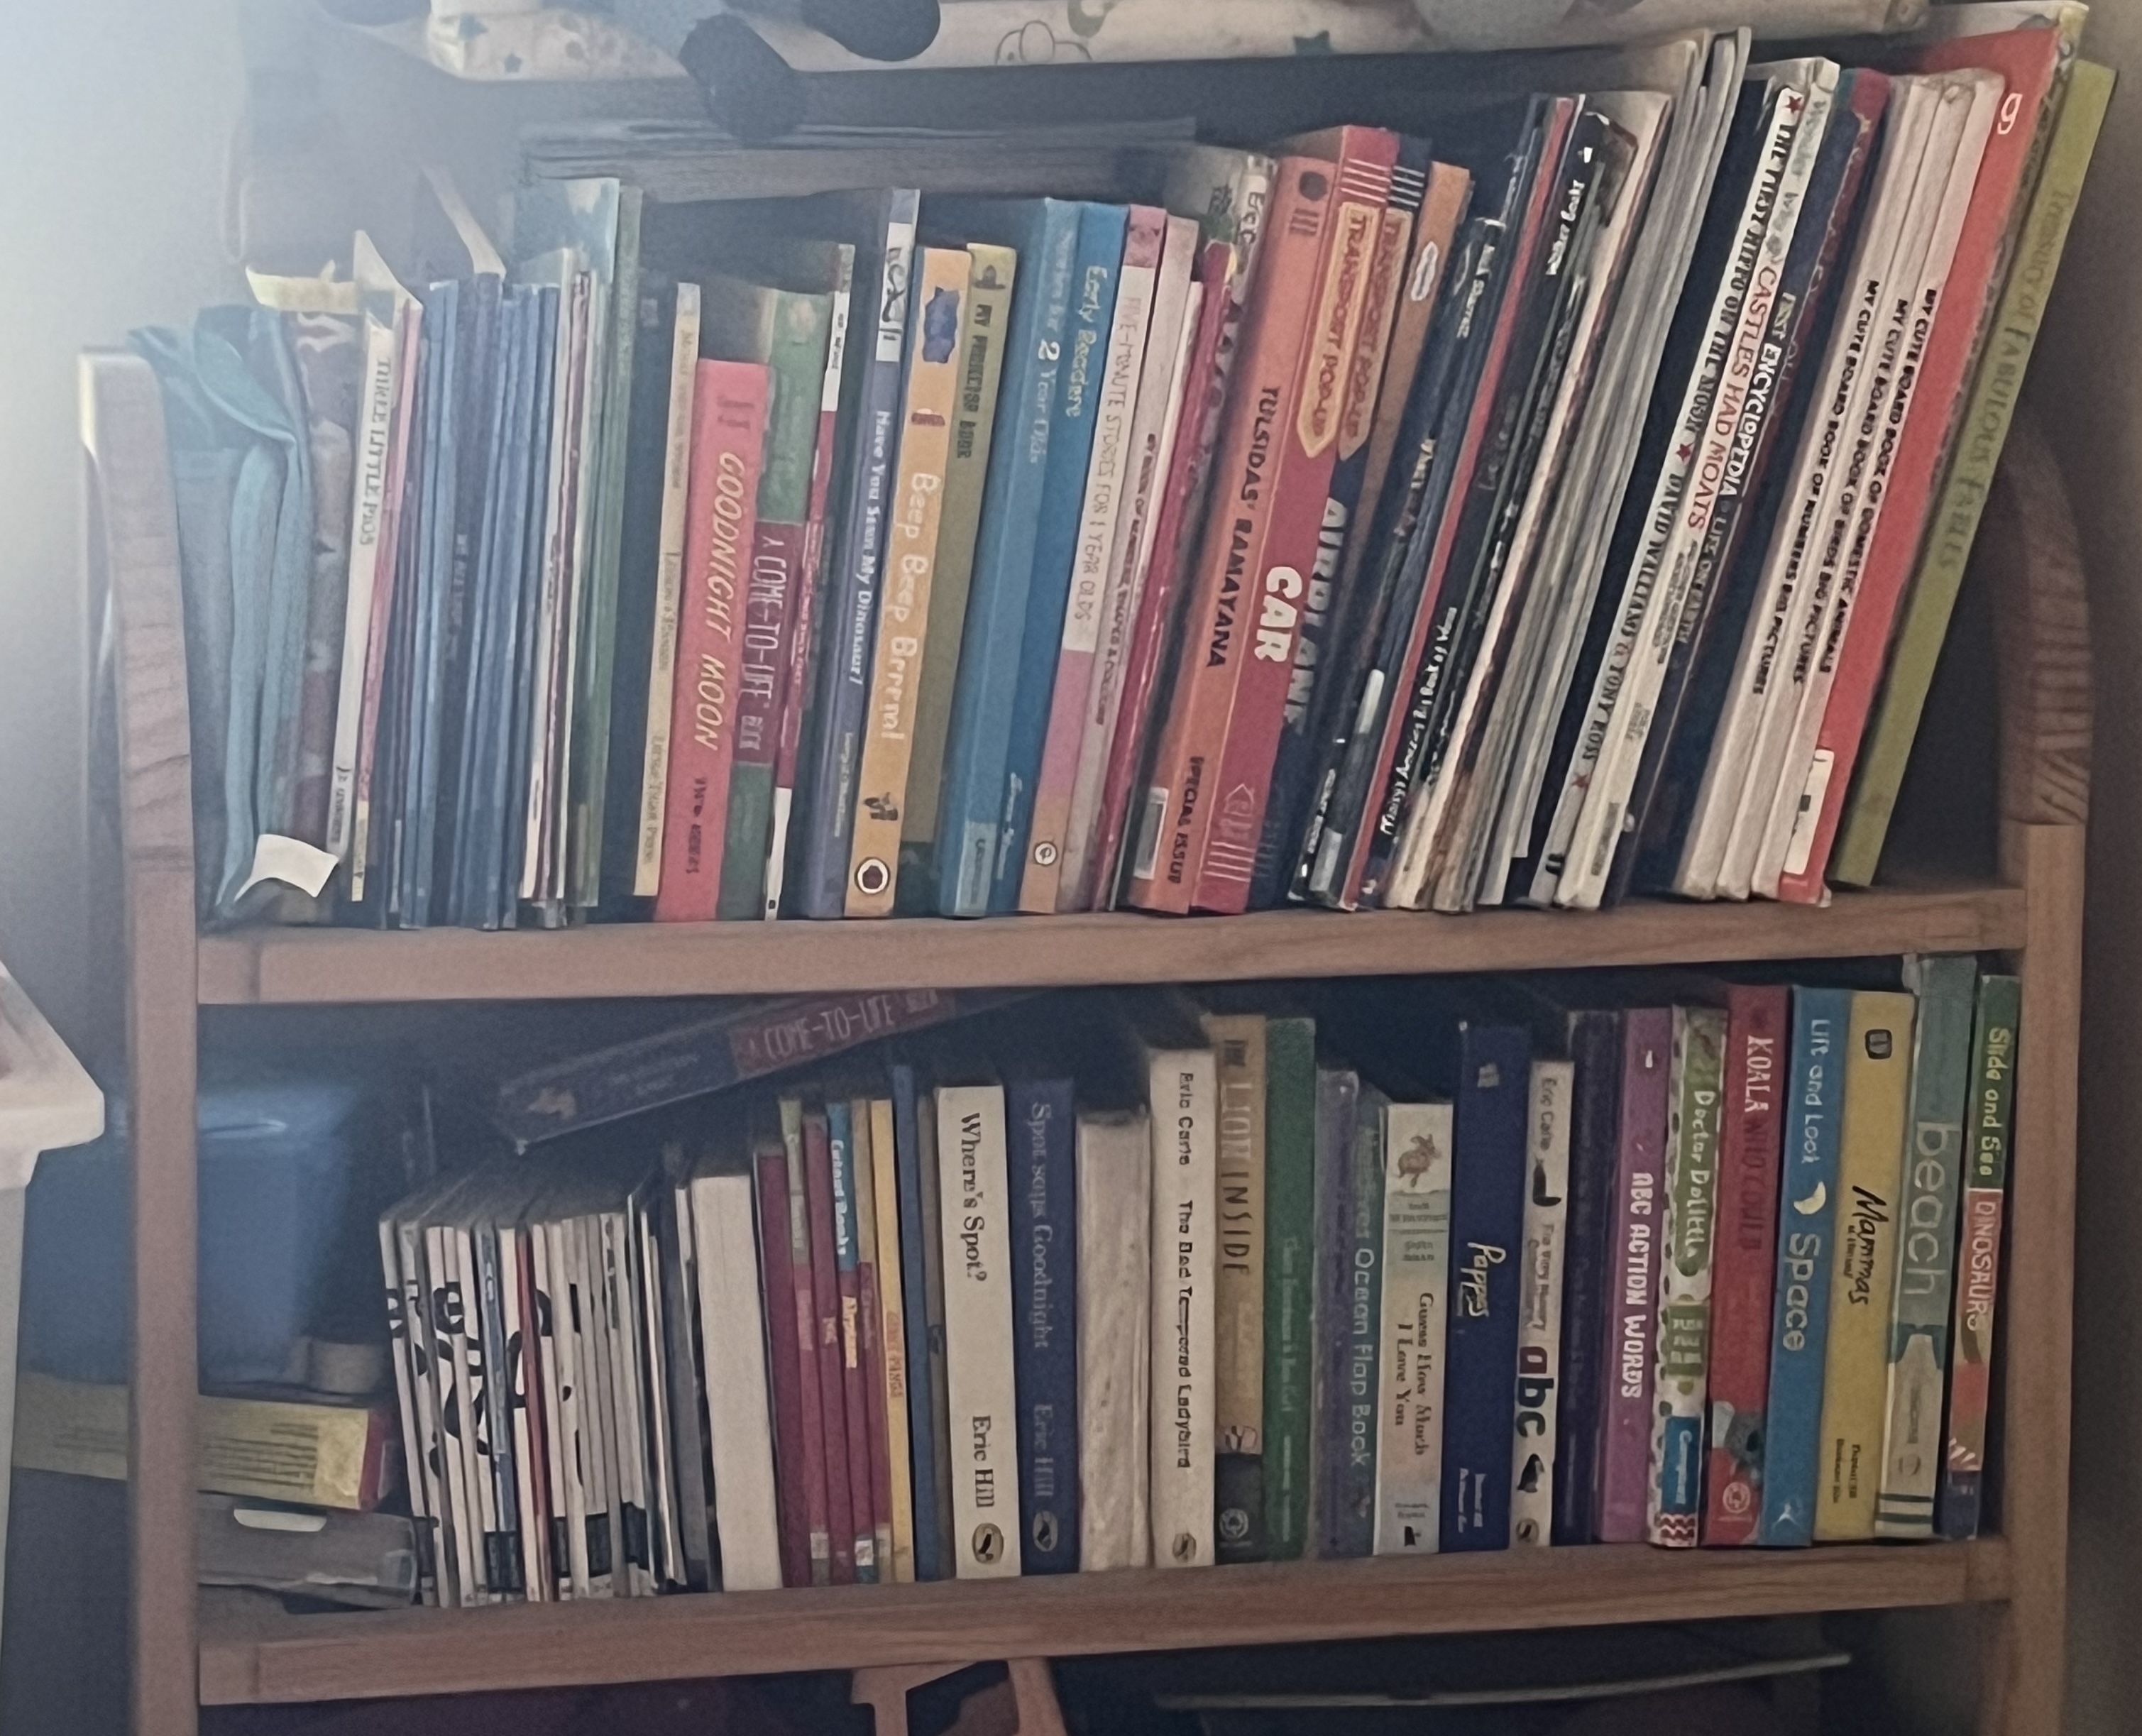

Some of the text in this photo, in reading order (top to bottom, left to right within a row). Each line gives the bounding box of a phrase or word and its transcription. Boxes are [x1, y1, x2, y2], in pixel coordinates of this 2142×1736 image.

[1076, 265, 1108, 322] Early
[1864, 280, 1880, 308] MY
[1891, 298, 1908, 327] MY
[1921, 288, 1938, 317] MY
[1038, 337, 1061, 361] 2
[1313, 215, 1366, 437] TRANSPORT POP-UP
[1849, 309, 1872, 353] CUTE
[1877, 328, 1901, 373] CUTE
[1906, 318, 1929, 363] CUTE
[1036, 368, 1057, 413] Year
[1687, 265, 1777, 529] CASTLES HAD MOATS
[1833, 356, 1858, 417] BOARD
[1860, 375, 1888, 436] BOARD
[1889, 365, 1916, 425] BOARD
[1718, 342, 1783, 497] ENCYCLOPEDIA
[1818, 419, 1840, 471] BOOK
[1845, 438, 1871, 489] BOOK
[1874, 427, 1897, 478] BOOK
[868, 464, 886, 500] You
[896, 471, 943, 539] Beep
[1812, 472, 1824, 497] OF
[1869, 480, 1882, 504] OF
[704, 451, 746, 643] GOODNIGHT
[1084, 534, 1104, 574] YEAR
[1703, 516, 1728, 556] LIFE
[857, 554, 877, 585] My
[891, 553, 929, 622] Beep
[1207, 517, 1253, 669] RAMAYANA
[740, 555, 787, 701] COME-TO-LIFE
[1074, 580, 1096, 620] OLDS
[1253, 566, 1303, 663] CAR
[694, 653, 727, 752] MOON
[763, 994, 895, 1062] COME-TO-LIFE
[1177, 1071, 1194, 1109] Eric
[1744, 1035, 1774, 1113] KOALA
[1800, 1017, 1831, 1164] Lift and Look
[1979, 1026, 2010, 1177] Slide and See
[1028, 1102, 1053, 1157] Spot
[1177, 1114, 1194, 1166] Carle
[1691, 1090, 1716, 1163] Doctor
[1177, 1199, 1194, 1235] The
[1221, 1171, 1253, 1275] INSIDE
[1902, 1120, 1962, 1295] beach
[1177, 1241, 1194, 1279] Bad
[1847, 1185, 1890, 1306] Mammas
[959, 1111, 996, 1508] Where's Spot? Eric Hill
[1028, 1223, 1054, 1349] Goodnight
[1352, 1247, 1375, 1335] Ocean
[1621, 1172, 1654, 1399] ABC ACTION WORDS
[1782, 1232, 1821, 1352] Space
[1417, 1292, 1434, 1348] Guess
[1350, 1343, 1373, 1397] Flap
[1395, 1338, 1412, 1382] Love
[1417, 1354, 1432, 1396] How
[1395, 1388, 1412, 1427] You
[1517, 1346, 1555, 1438] abc
[1033, 1403, 1054, 1451] Eric
[1175, 1383, 1194, 1469] Ladybird
[1350, 1403, 1371, 1467] Book
[1033, 1456, 1054, 1497] Hill
